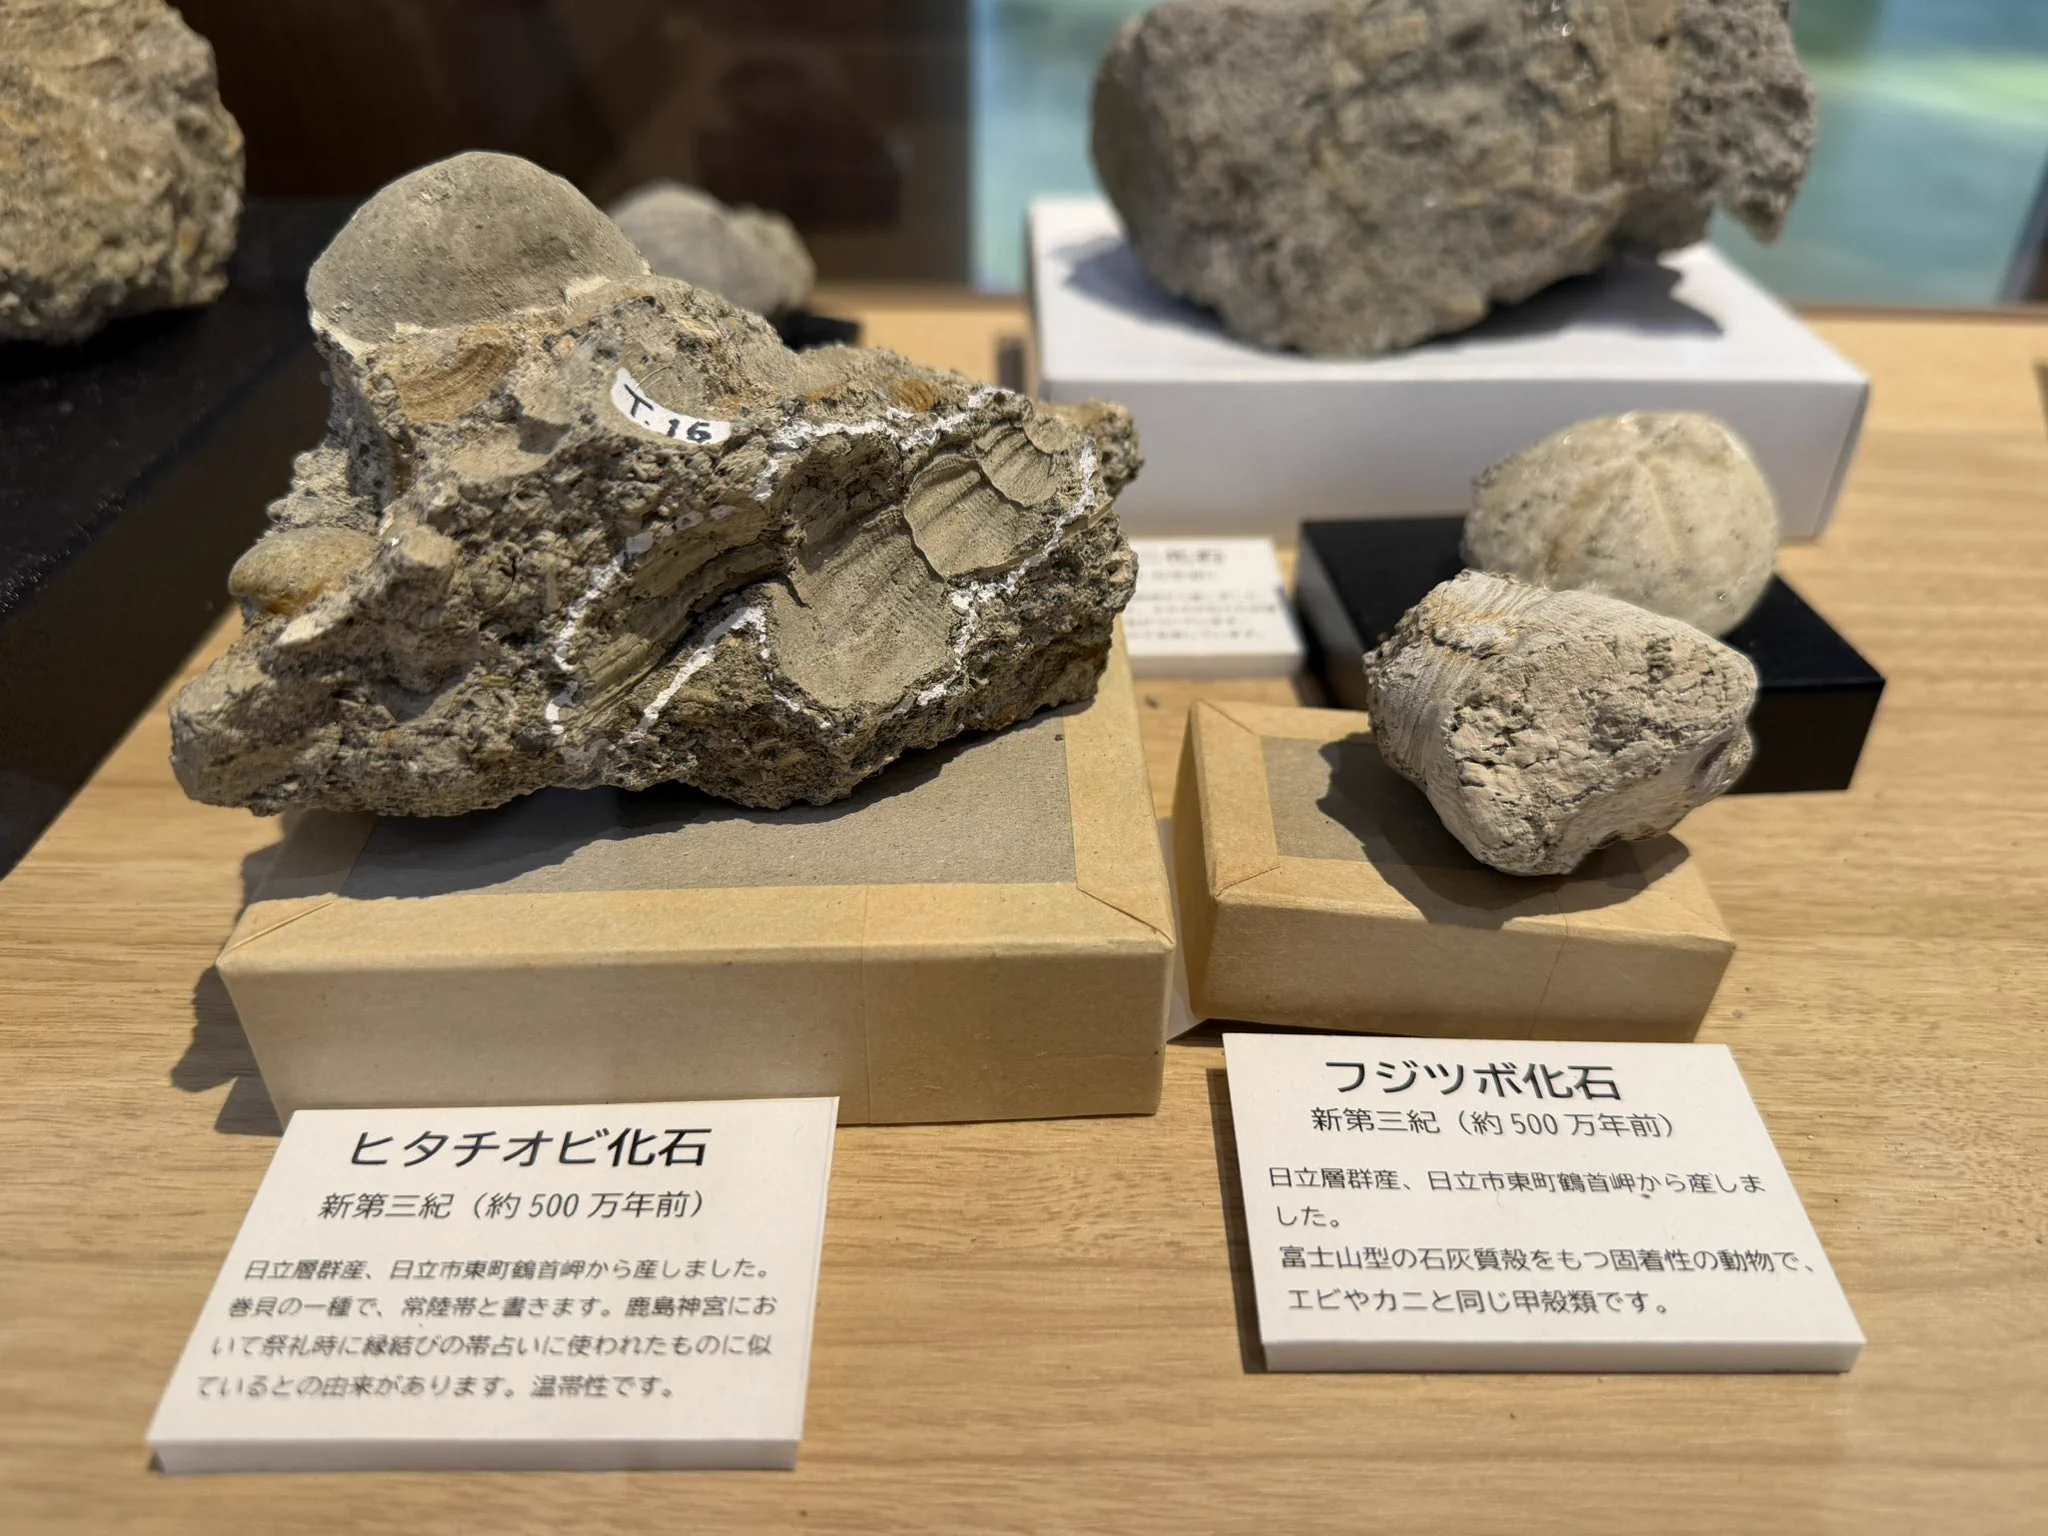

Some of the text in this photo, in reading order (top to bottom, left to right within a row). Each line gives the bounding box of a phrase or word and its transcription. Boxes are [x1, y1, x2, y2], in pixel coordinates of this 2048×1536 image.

[1325, 1060, 1622, 1101] フジツボ化石
[351, 1127, 712, 1168] ヒタチオビ化石
[1269, 1166, 1766, 1194] 日立層群産、日立市東町鶴首岬から産しま
[1276, 1205, 1340, 1228] した。
[1279, 1244, 1814, 1273] 富士山型の石灰質殻をもつ固着性の動物で、
[1287, 1288, 1668, 1314] エビやカニと同じ甲殻類です。
